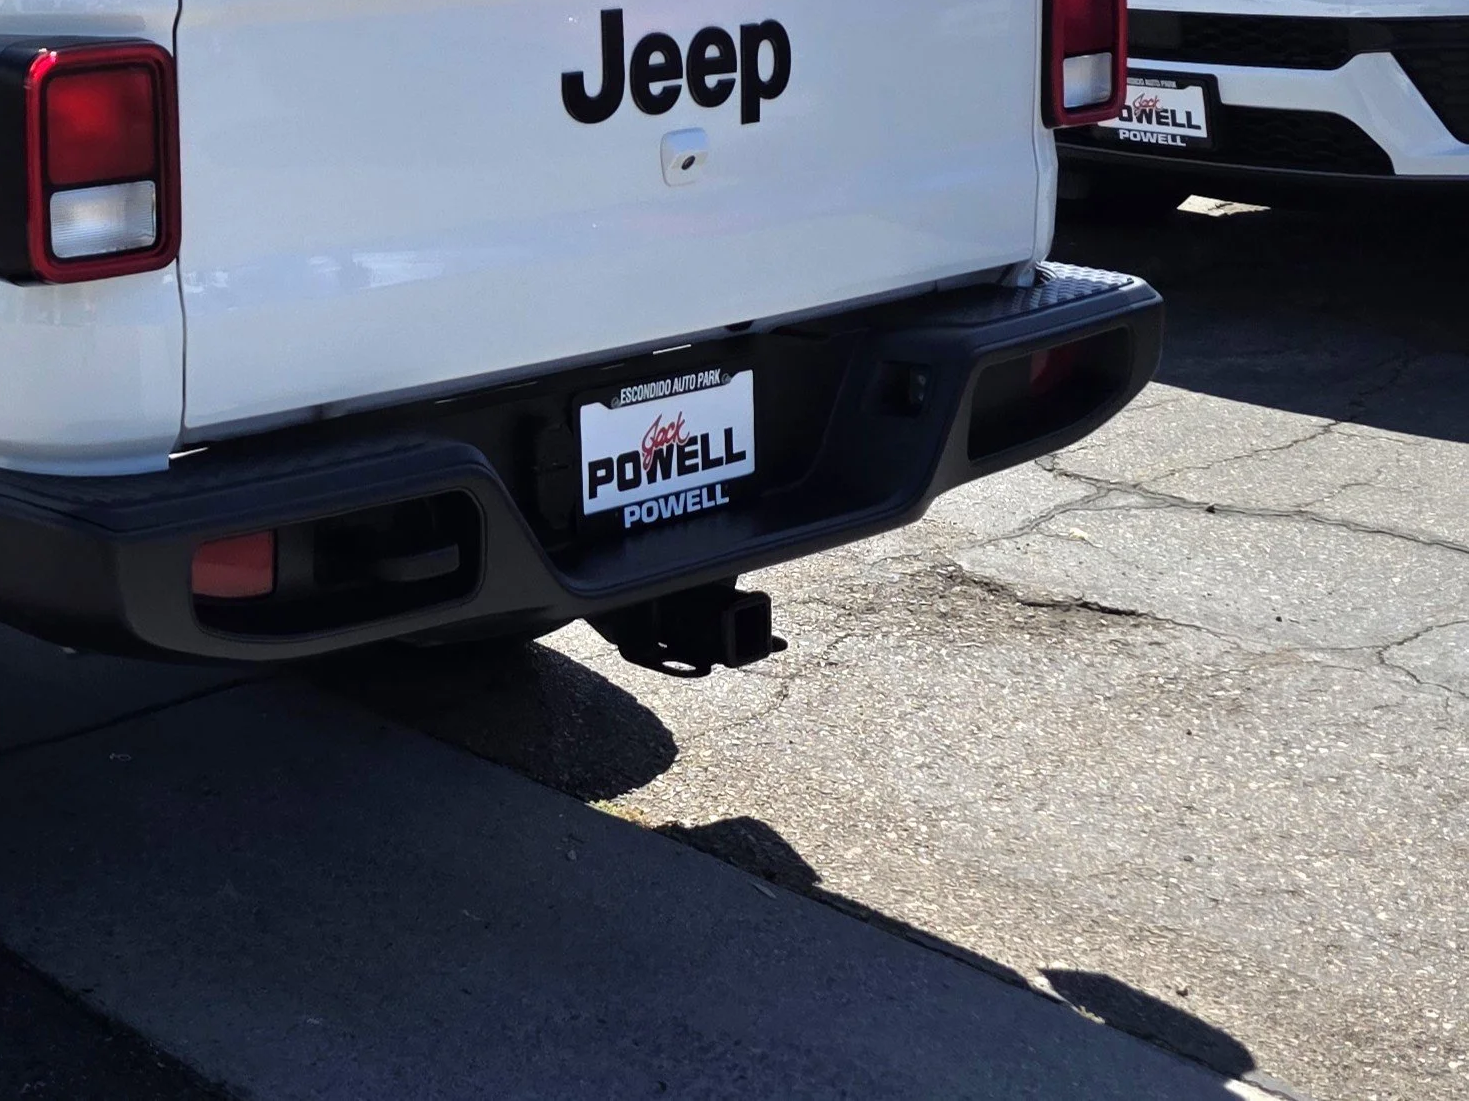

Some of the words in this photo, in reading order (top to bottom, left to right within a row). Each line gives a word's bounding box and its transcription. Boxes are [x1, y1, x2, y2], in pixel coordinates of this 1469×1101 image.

[561, 8, 792, 125] Jeep
[1118, 105, 1202, 130] OWELL
[1132, 93, 1163, 117] Jack
[1119, 129, 1187, 147] POWELL
[620, 379, 672, 405] ESCONDIDO
[672, 374, 696, 394] AUTO
[697, 368, 721, 388] PARK
[642, 411, 690, 471] Jack
[587, 427, 747, 501] POWELL
[624, 484, 730, 529] POWELL
